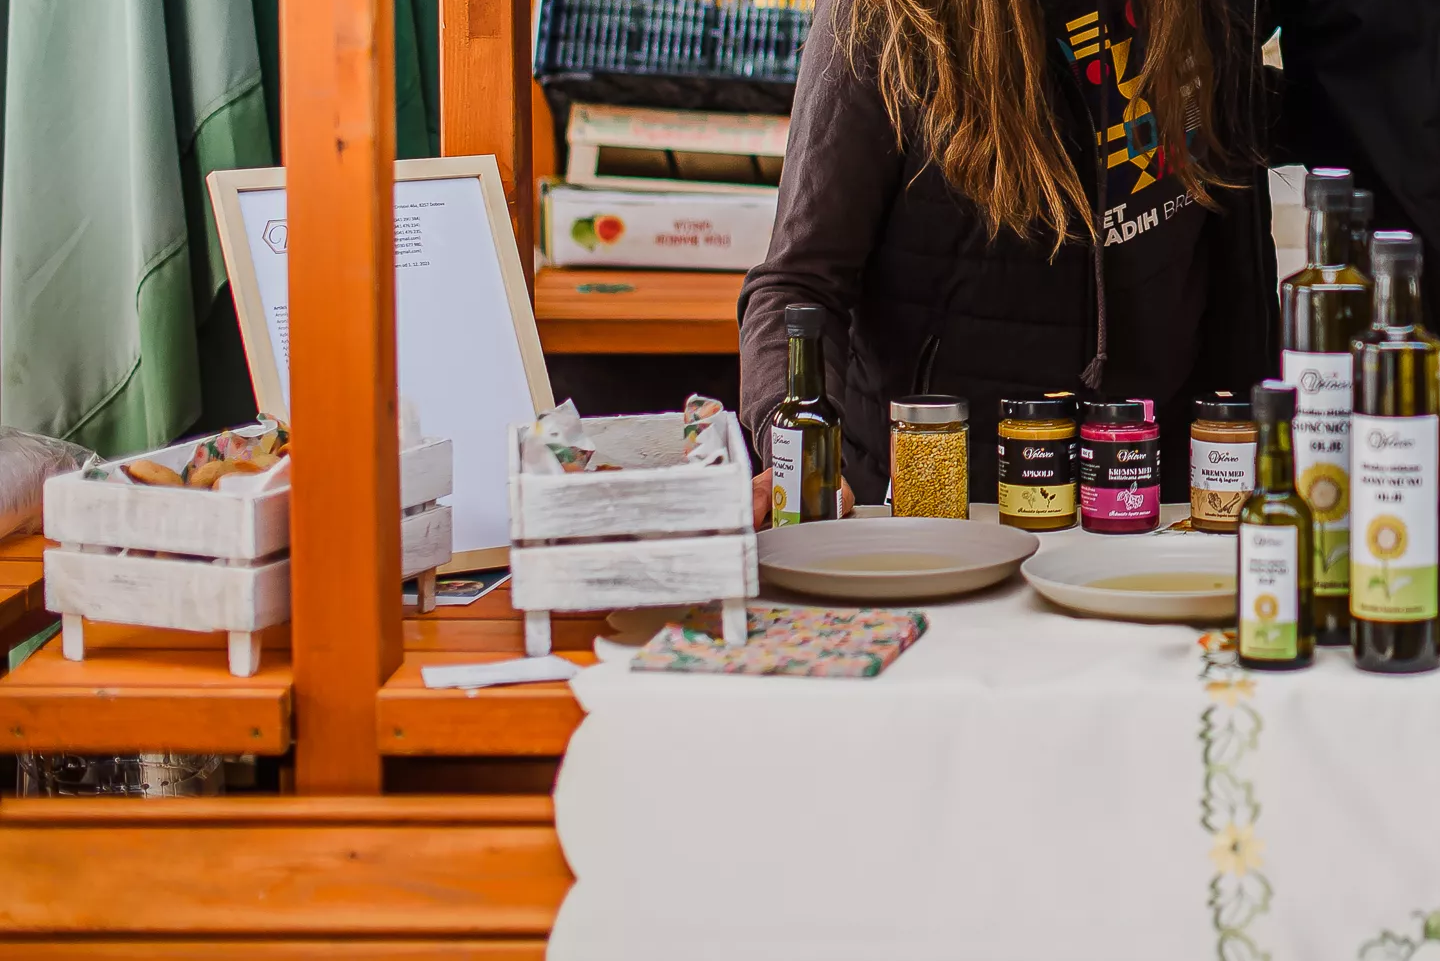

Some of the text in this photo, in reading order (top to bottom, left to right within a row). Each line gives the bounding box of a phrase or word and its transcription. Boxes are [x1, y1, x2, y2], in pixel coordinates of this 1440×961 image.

[1103, 203, 1127, 228] ET
[1103, 189, 1200, 247] ADIH BRE
[1108, 467, 1137, 476] KREMNI
[1201, 469, 1227, 477] KREMNI
